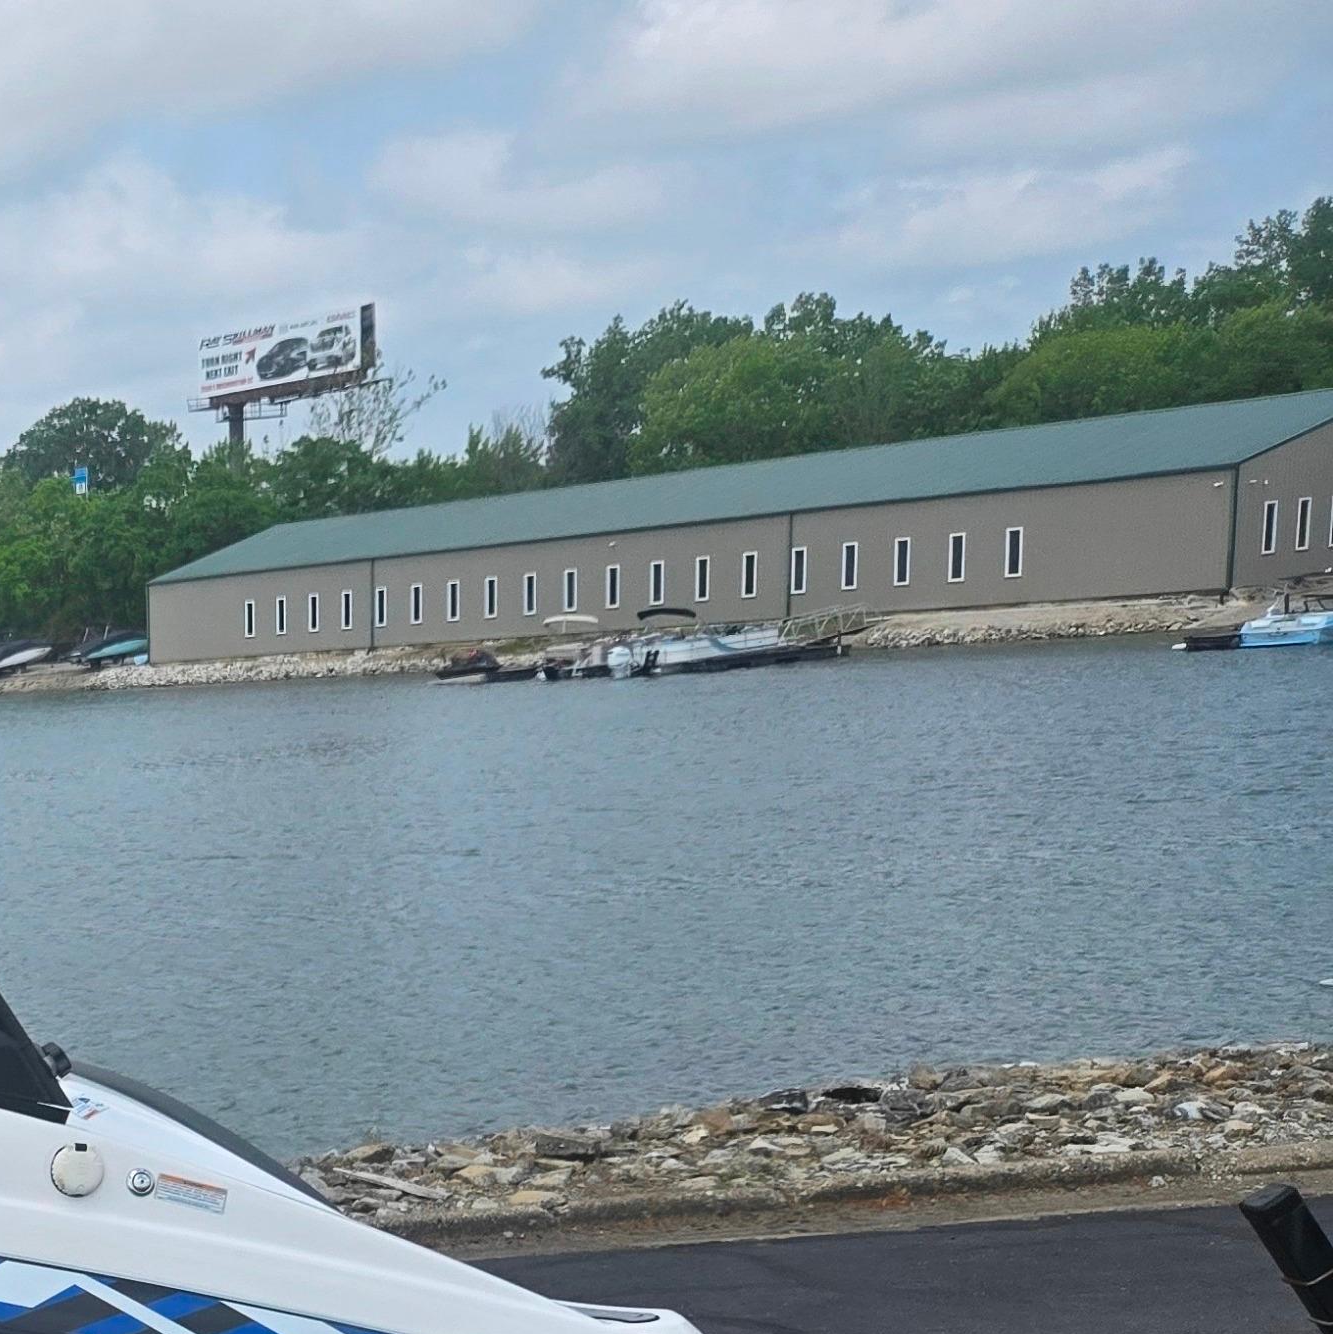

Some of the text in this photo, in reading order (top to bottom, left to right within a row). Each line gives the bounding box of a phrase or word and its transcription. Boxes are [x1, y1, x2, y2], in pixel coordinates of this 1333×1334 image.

[202, 352, 242, 369] TURN RIGHT
[205, 365, 239, 381] NEXT EXIT
